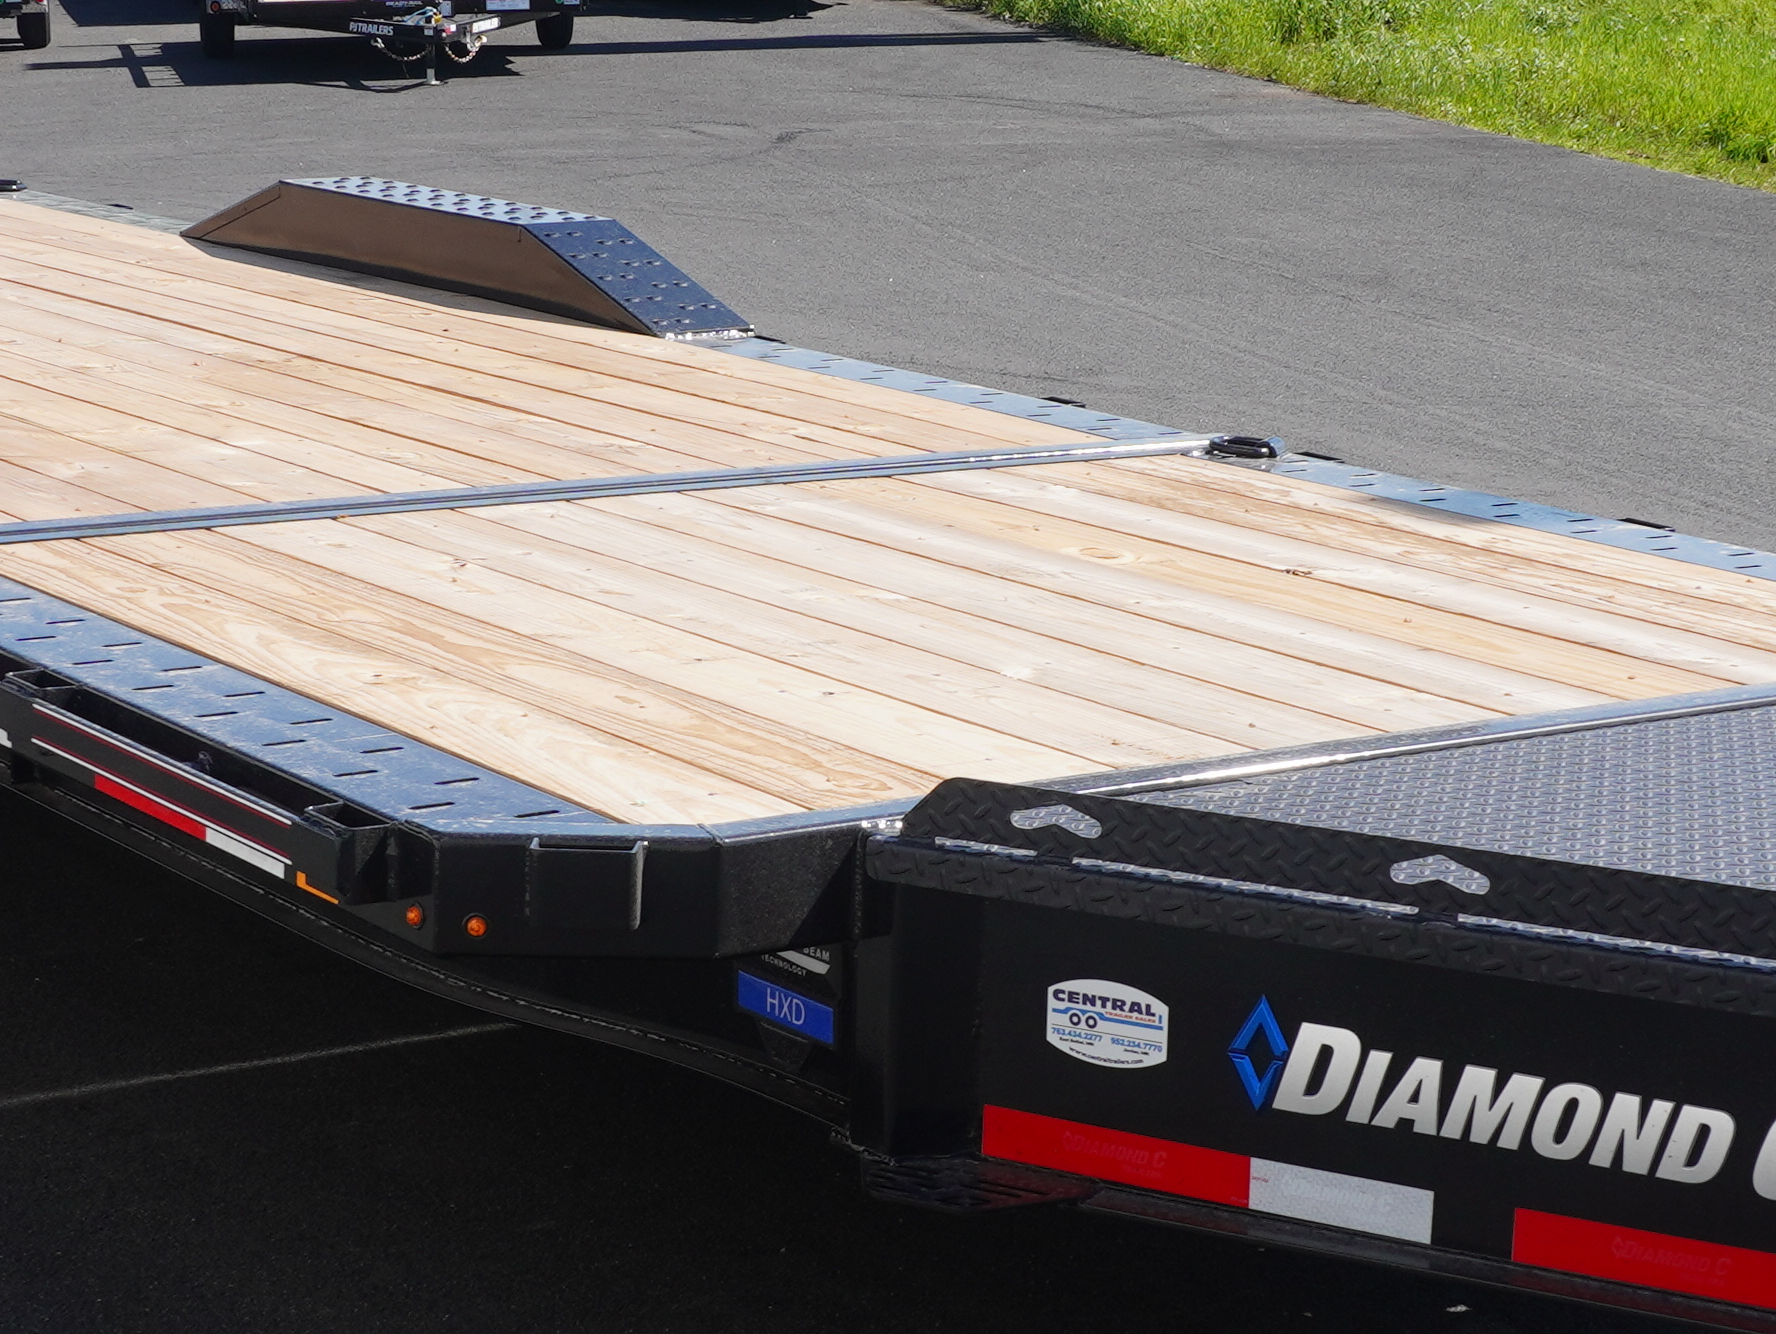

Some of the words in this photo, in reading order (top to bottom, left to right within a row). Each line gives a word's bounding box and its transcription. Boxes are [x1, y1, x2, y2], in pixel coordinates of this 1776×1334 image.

[766, 987, 806, 1025] HXD
[1052, 988, 1157, 1018] CENTRAL
[1271, 1021, 1737, 1185] DIAMOND
